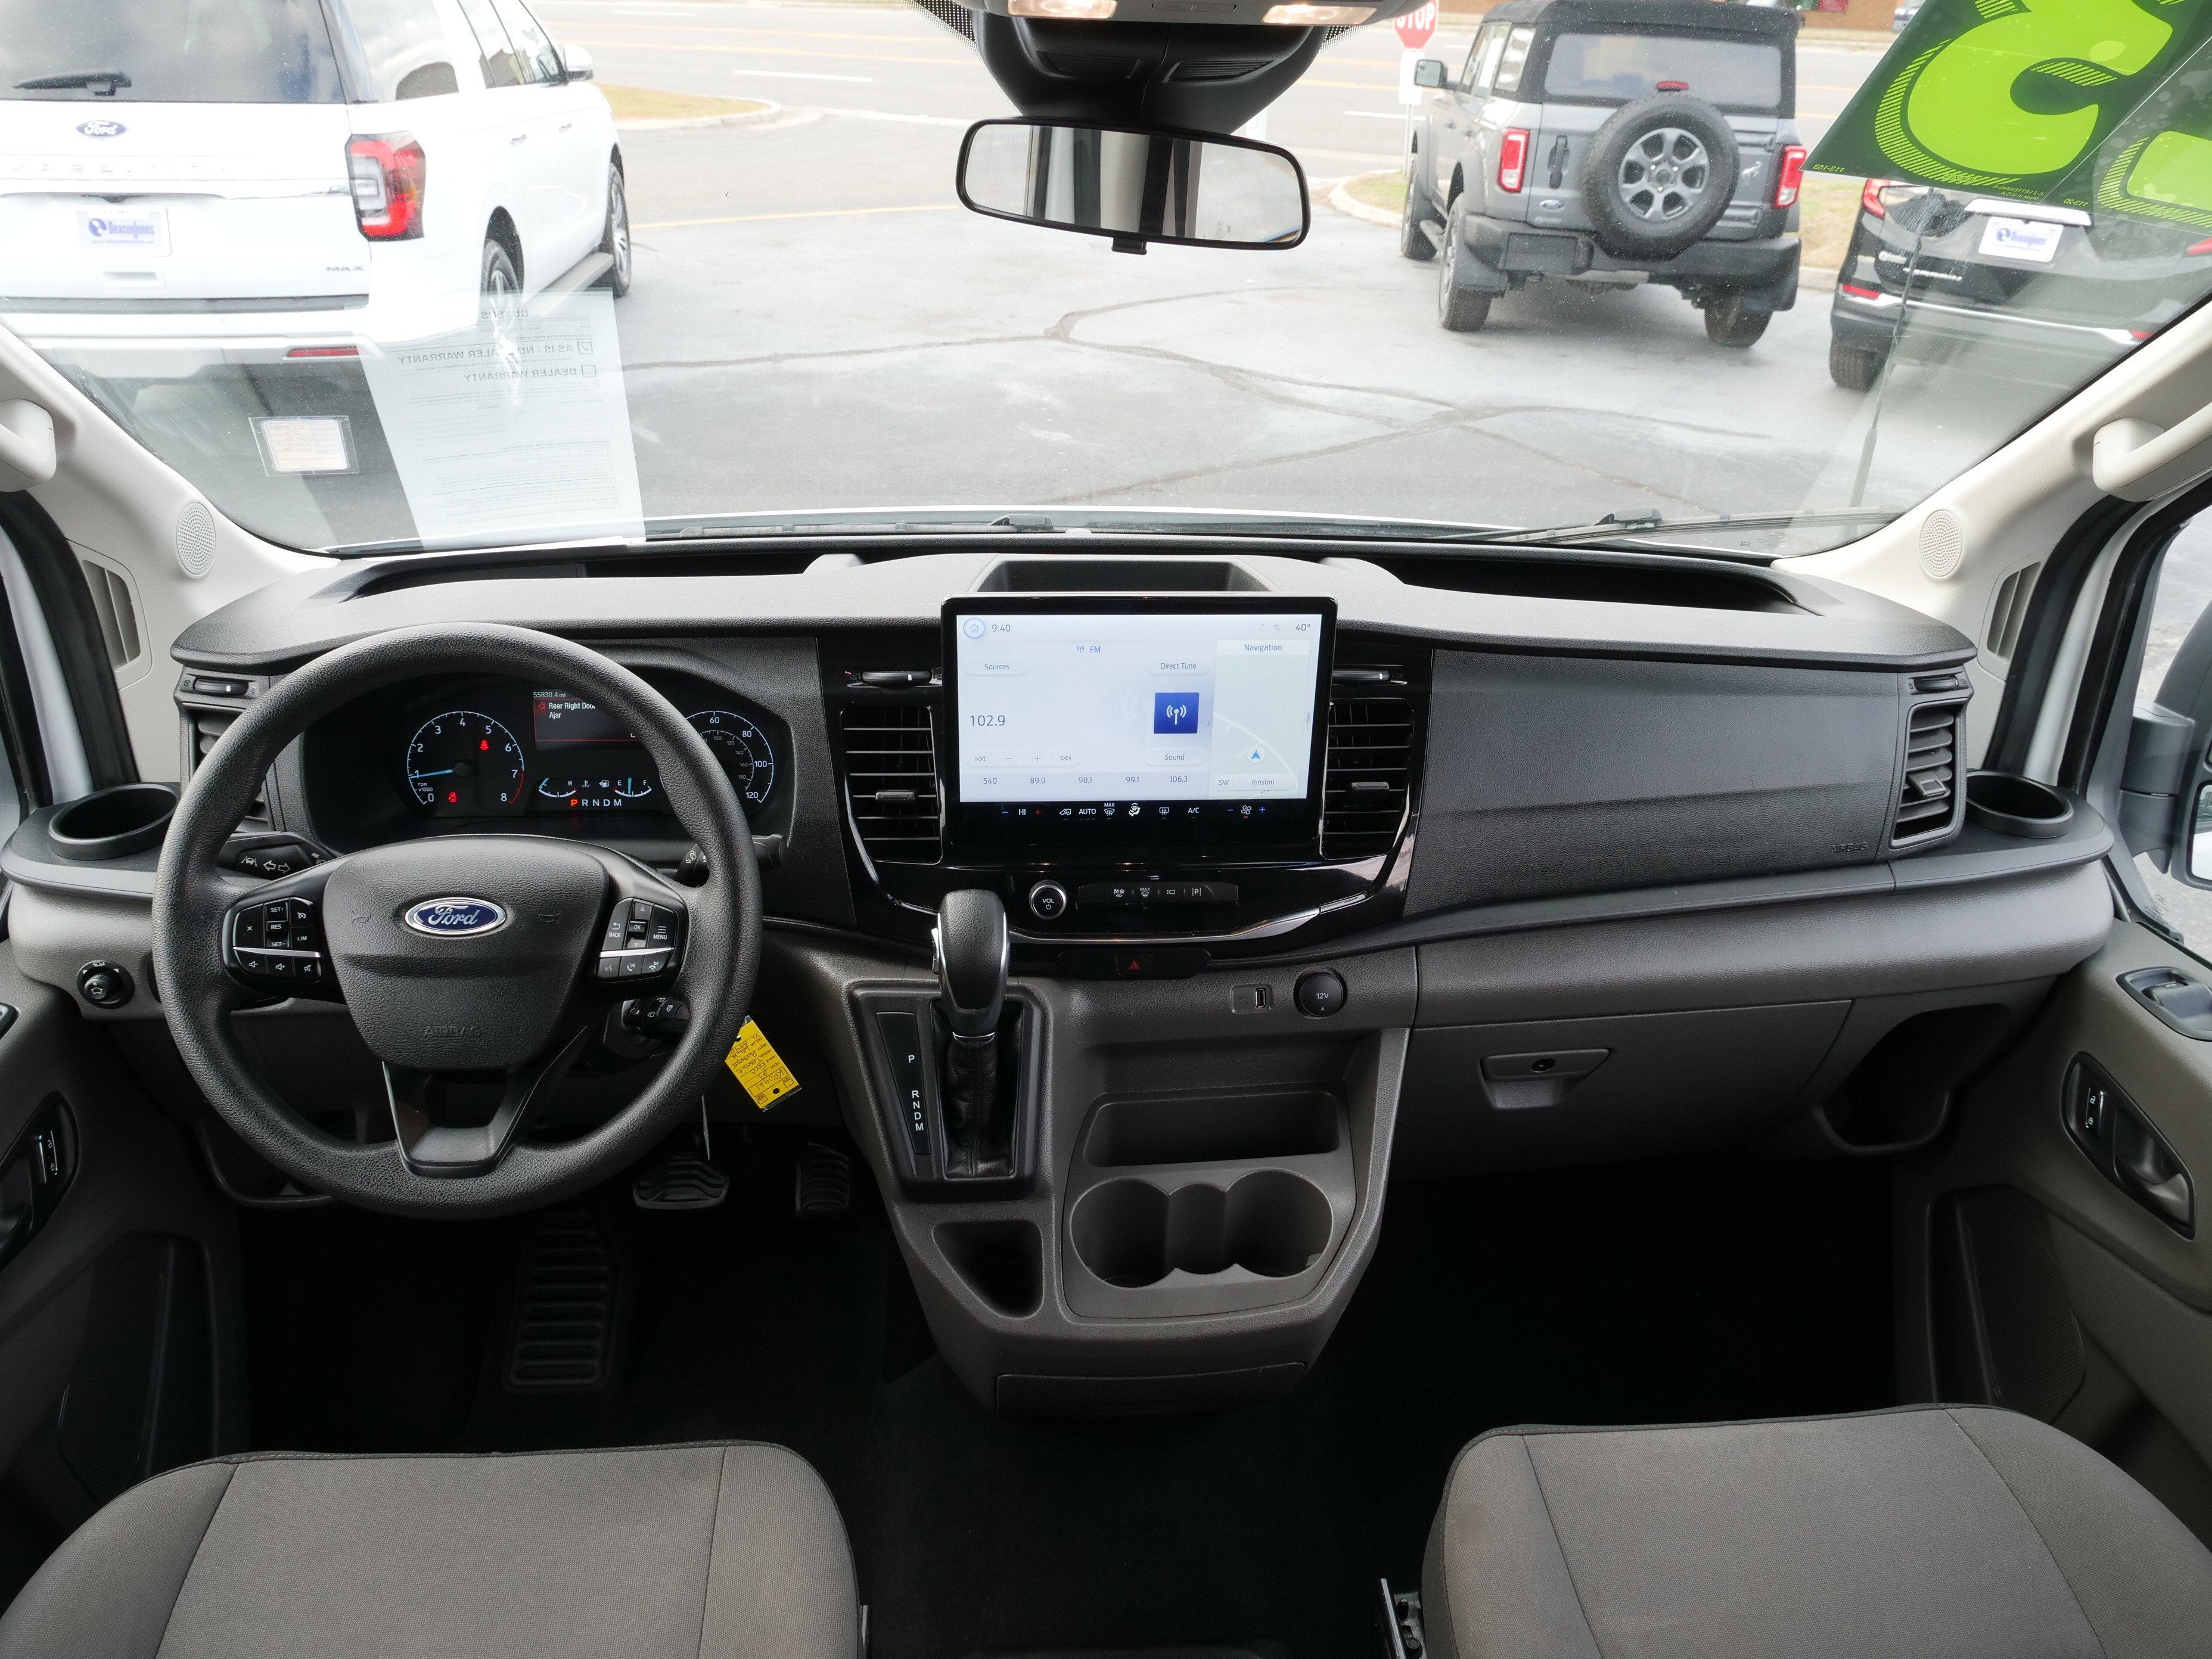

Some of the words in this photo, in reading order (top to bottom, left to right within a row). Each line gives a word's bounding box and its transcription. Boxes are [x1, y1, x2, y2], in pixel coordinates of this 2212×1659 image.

[84, 120, 118, 135] Ford
[564, 702, 580, 710] Right
[549, 712, 561, 720] Ajar
[459, 718, 466, 726] 4
[971, 715, 1005, 726] 102.9
[435, 725, 442, 734] 3
[486, 725, 492, 734] 5
[417, 744, 424, 752] 2
[505, 744, 511, 752] 6
[511, 769, 518, 778] 7
[428, 793, 434, 801] 0
[501, 793, 507, 801] 8
[428, 905, 480, 925] Ford
[908, 1055, 915, 1063] P
[912, 1090, 919, 1098] R
[913, 1101, 920, 1109] N
[914, 1112, 921, 1120] D
[915, 1122, 924, 1131] M
